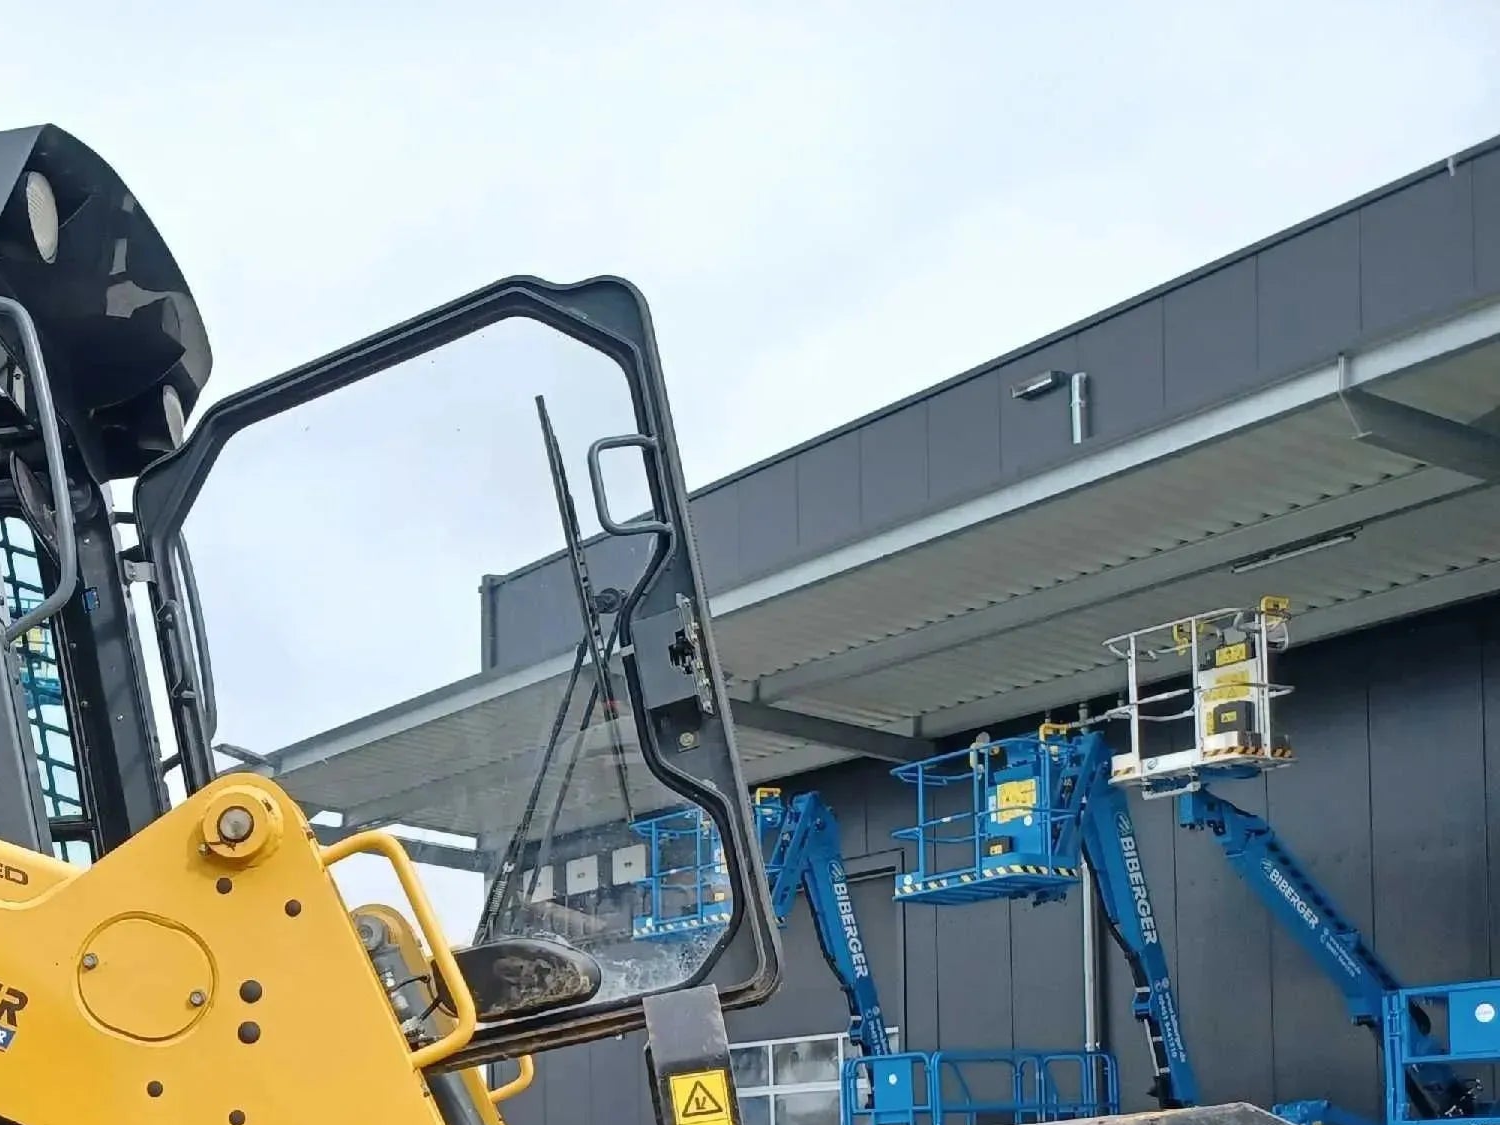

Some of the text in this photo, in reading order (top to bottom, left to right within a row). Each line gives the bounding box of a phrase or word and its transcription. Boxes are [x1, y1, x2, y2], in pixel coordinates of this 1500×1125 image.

[833, 882, 869, 979] BIBERGER
[1121, 836, 1158, 945] BIBERGER
[1270, 868, 1319, 930] BIBERGER
